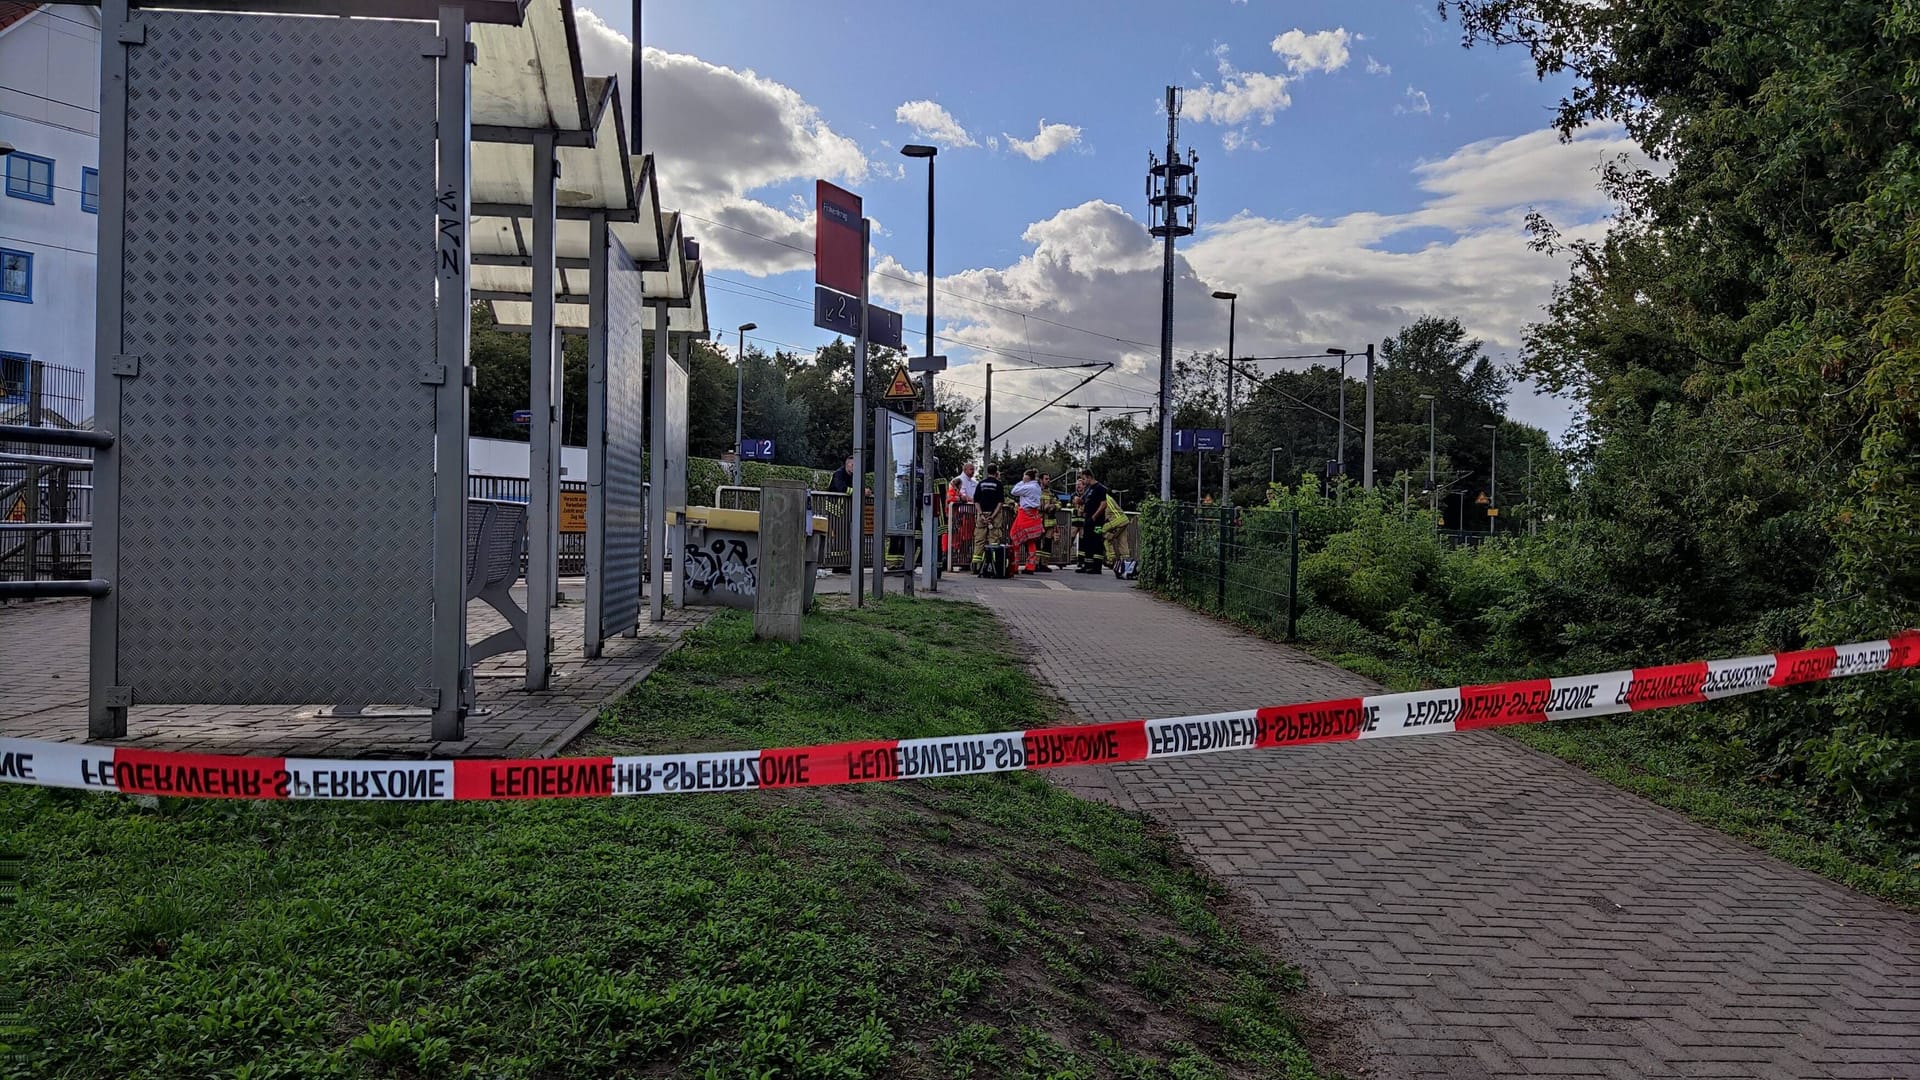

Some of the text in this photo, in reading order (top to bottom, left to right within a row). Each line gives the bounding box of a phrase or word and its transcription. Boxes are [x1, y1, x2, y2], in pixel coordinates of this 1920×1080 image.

[838, 296, 846, 319] 2
[887, 313, 892, 328] 1
[1175, 430, 1182, 446] 1
[763, 440, 772, 455] 2
